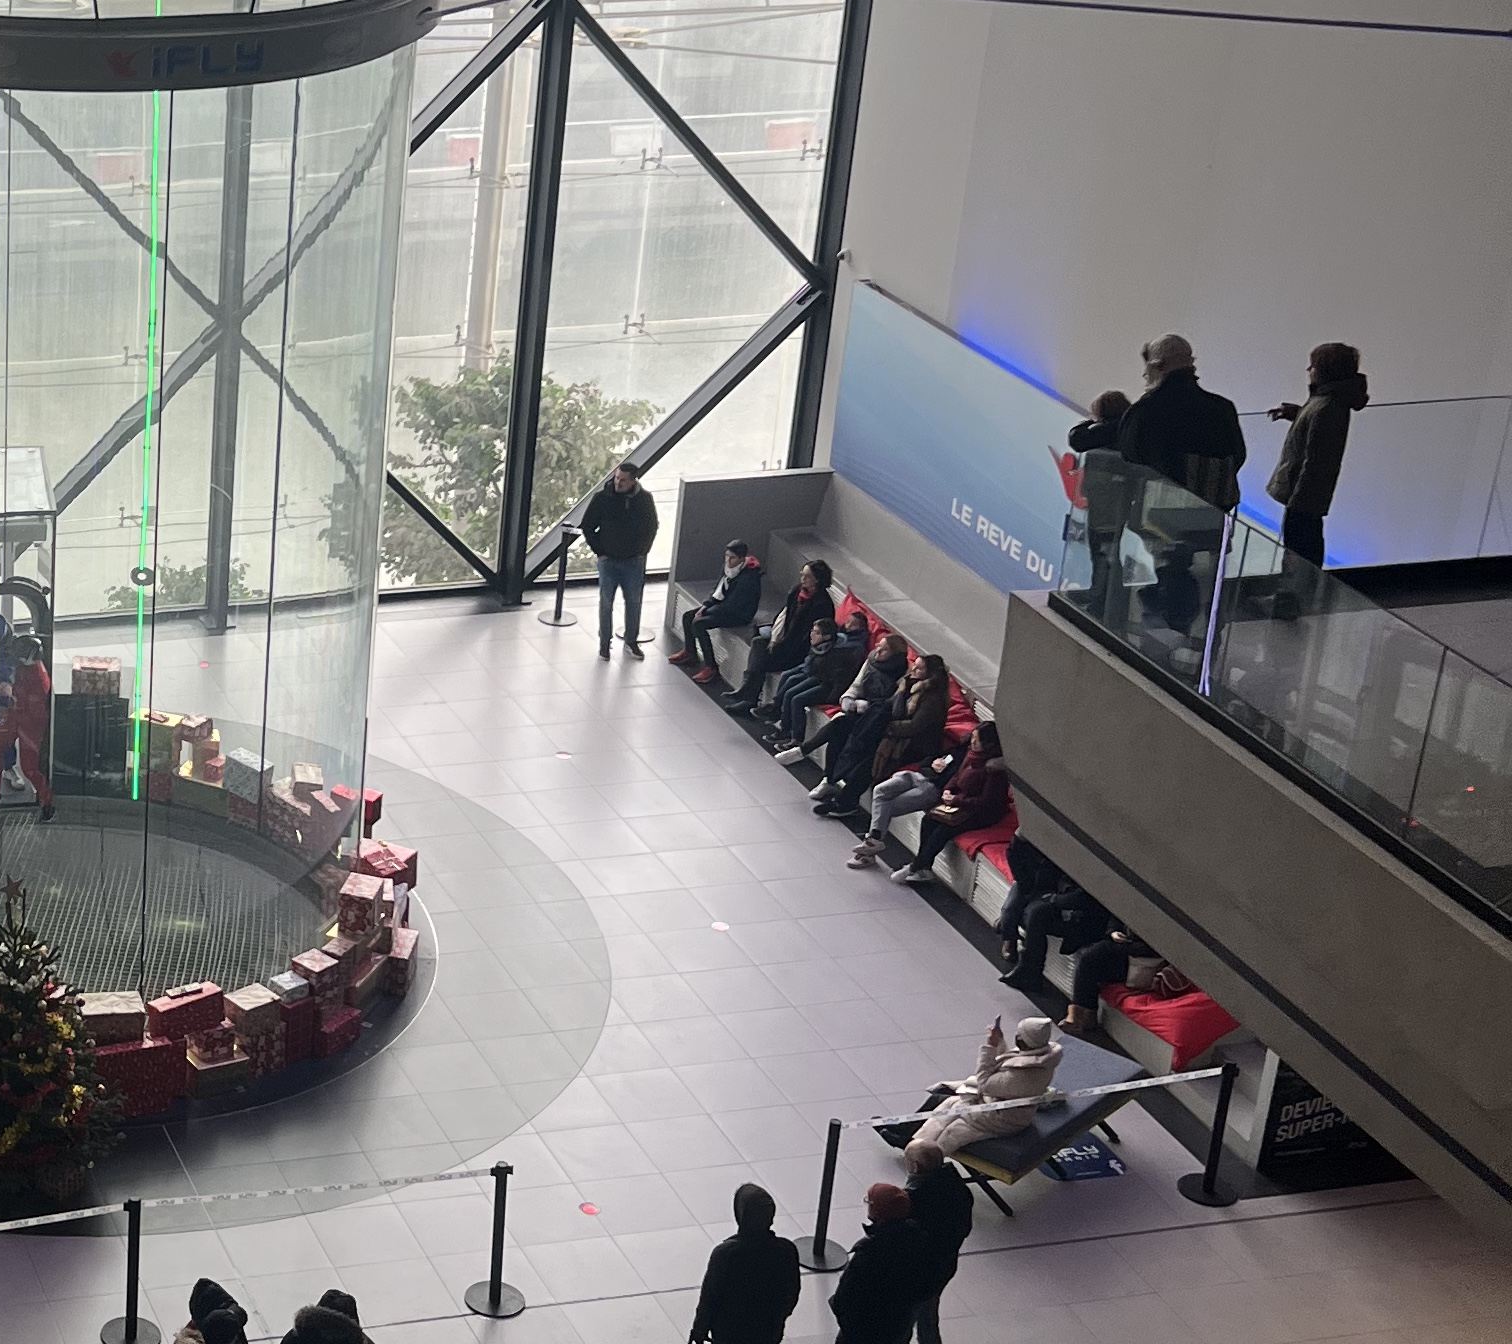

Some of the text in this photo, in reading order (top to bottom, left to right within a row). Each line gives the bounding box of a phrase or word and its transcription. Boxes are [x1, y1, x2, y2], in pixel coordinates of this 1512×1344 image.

[951, 497, 1054, 583] LE REVE DU
[1279, 1096, 1334, 1123] DEVIE
[1274, 1112, 1346, 1143] SUPER-
